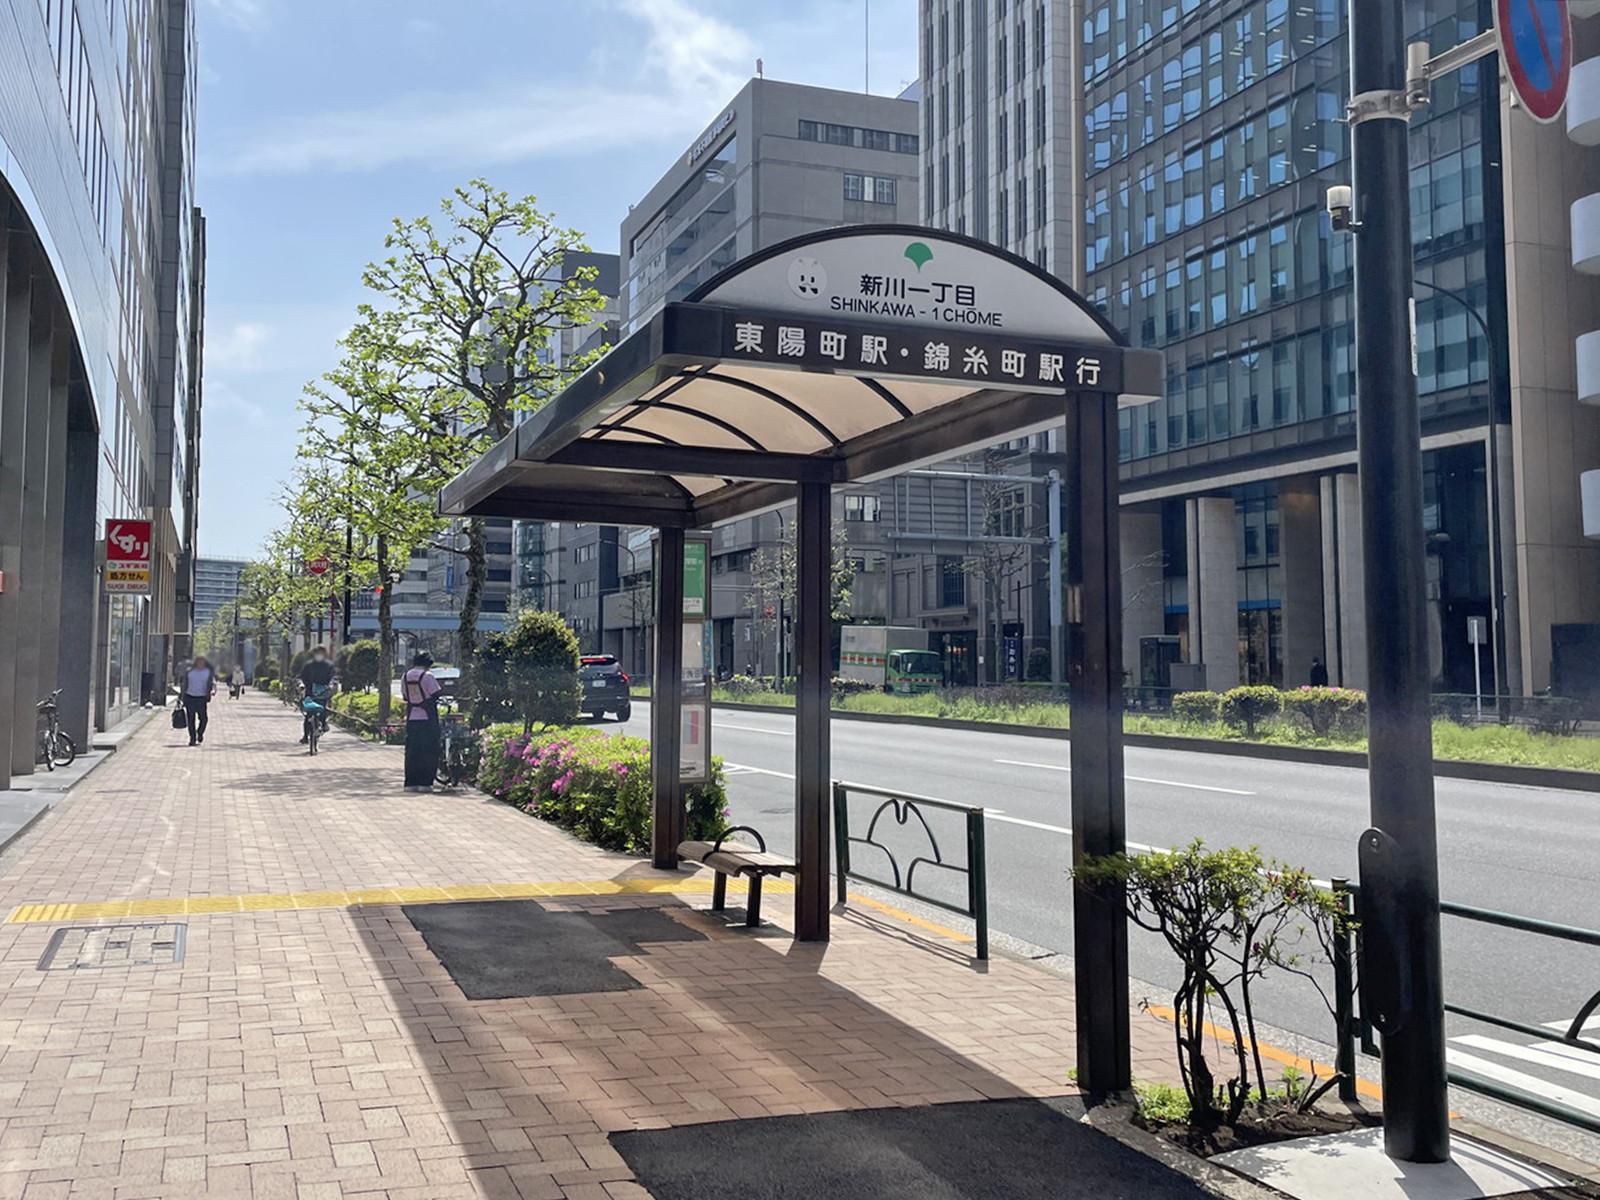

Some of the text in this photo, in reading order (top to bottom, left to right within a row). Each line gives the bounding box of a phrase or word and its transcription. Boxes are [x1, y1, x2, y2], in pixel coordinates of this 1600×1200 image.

[860, 274, 976, 307] 新川一丁目
[830, 296, 915, 319] SHINKAWA
[735, 321, 1101, 386] 東陽町駅・錦糸町駅行
[109, 524, 149, 558] くすり
